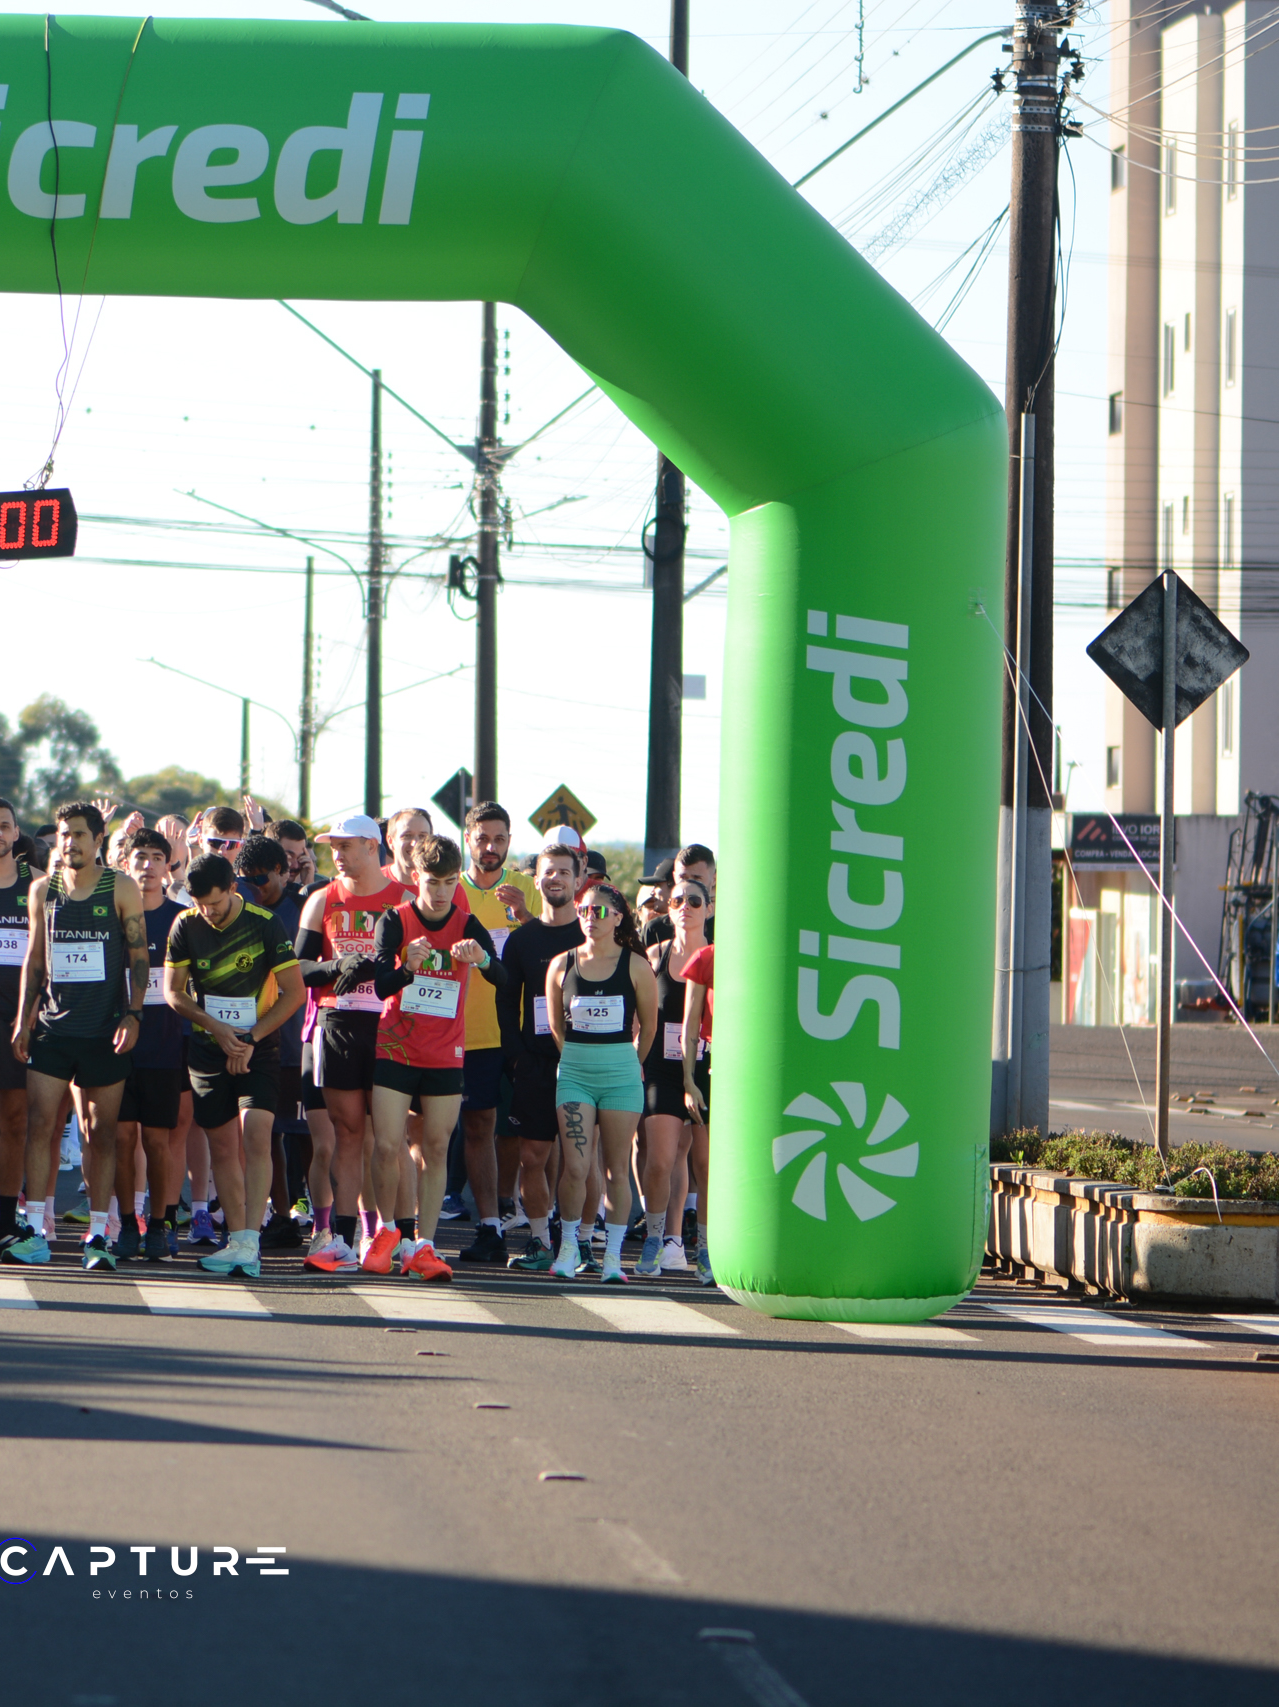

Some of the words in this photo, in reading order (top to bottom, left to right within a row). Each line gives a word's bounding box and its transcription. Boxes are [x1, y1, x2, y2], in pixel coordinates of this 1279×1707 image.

[797, 608, 909, 1050] Sicredi
[65, 953, 88, 963] 174
[147, 979, 158, 988] 61
[418, 987, 442, 999] 072
[217, 1010, 240, 1020] 173
[585, 1008, 609, 1017] 125
